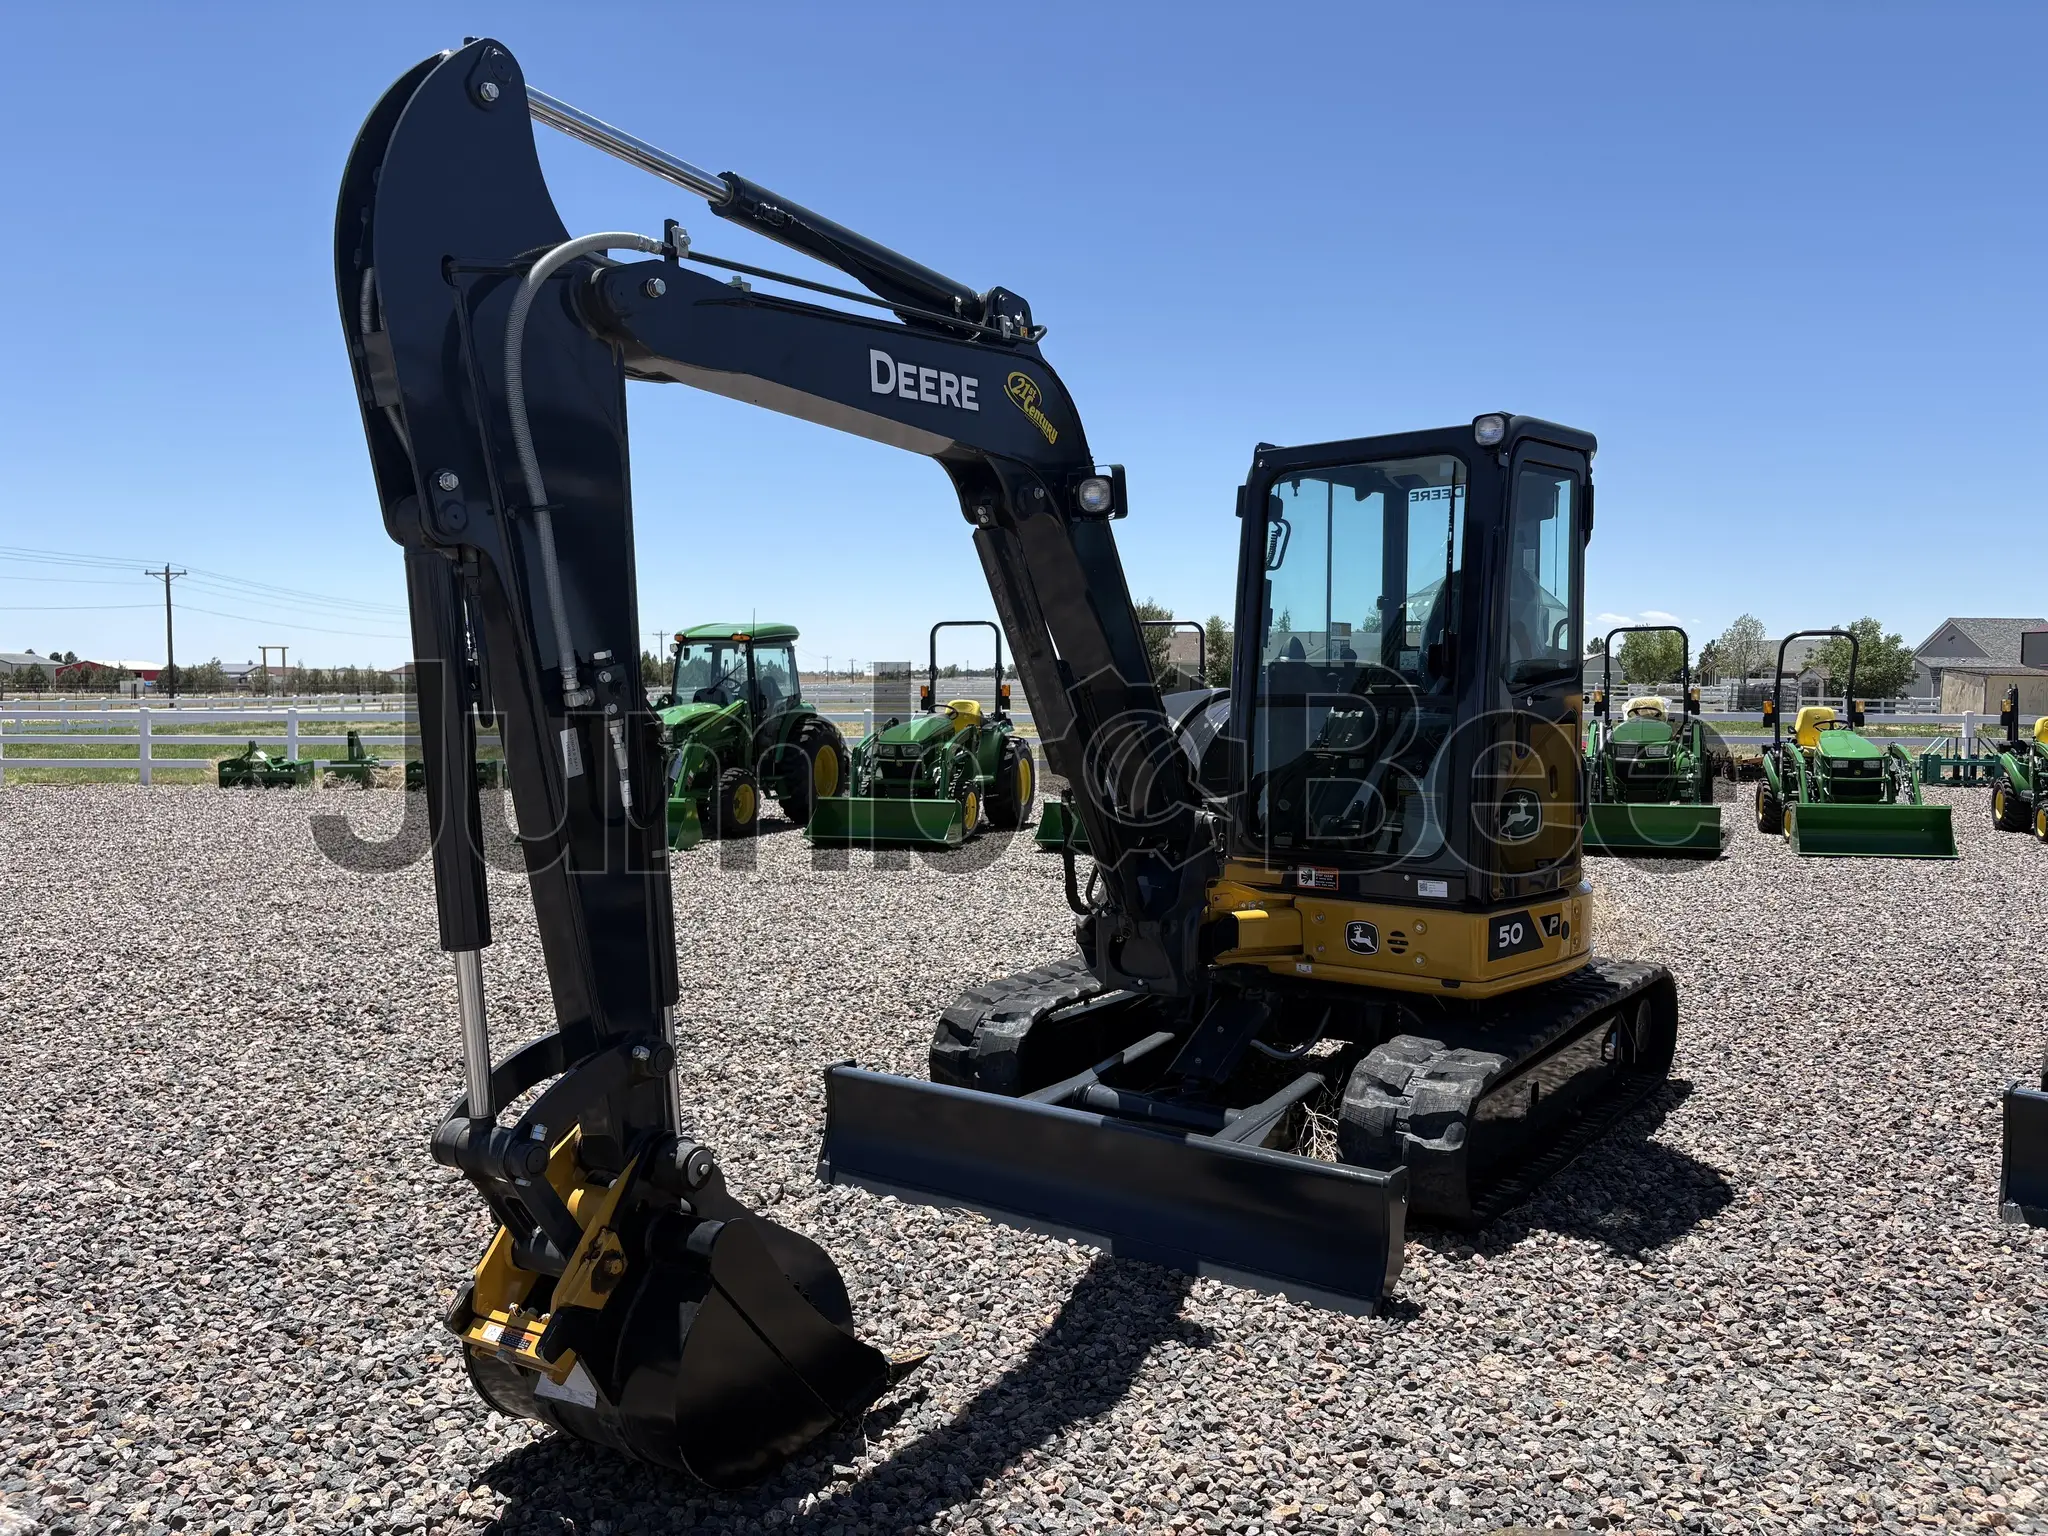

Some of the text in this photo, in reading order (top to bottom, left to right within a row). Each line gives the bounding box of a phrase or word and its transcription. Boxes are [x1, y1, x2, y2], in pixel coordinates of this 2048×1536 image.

[869, 348, 980, 412] DEERE
[1011, 377, 1037, 400] 21st
[1023, 395, 1059, 445] Century
[1499, 915, 1560, 948] 50 P
